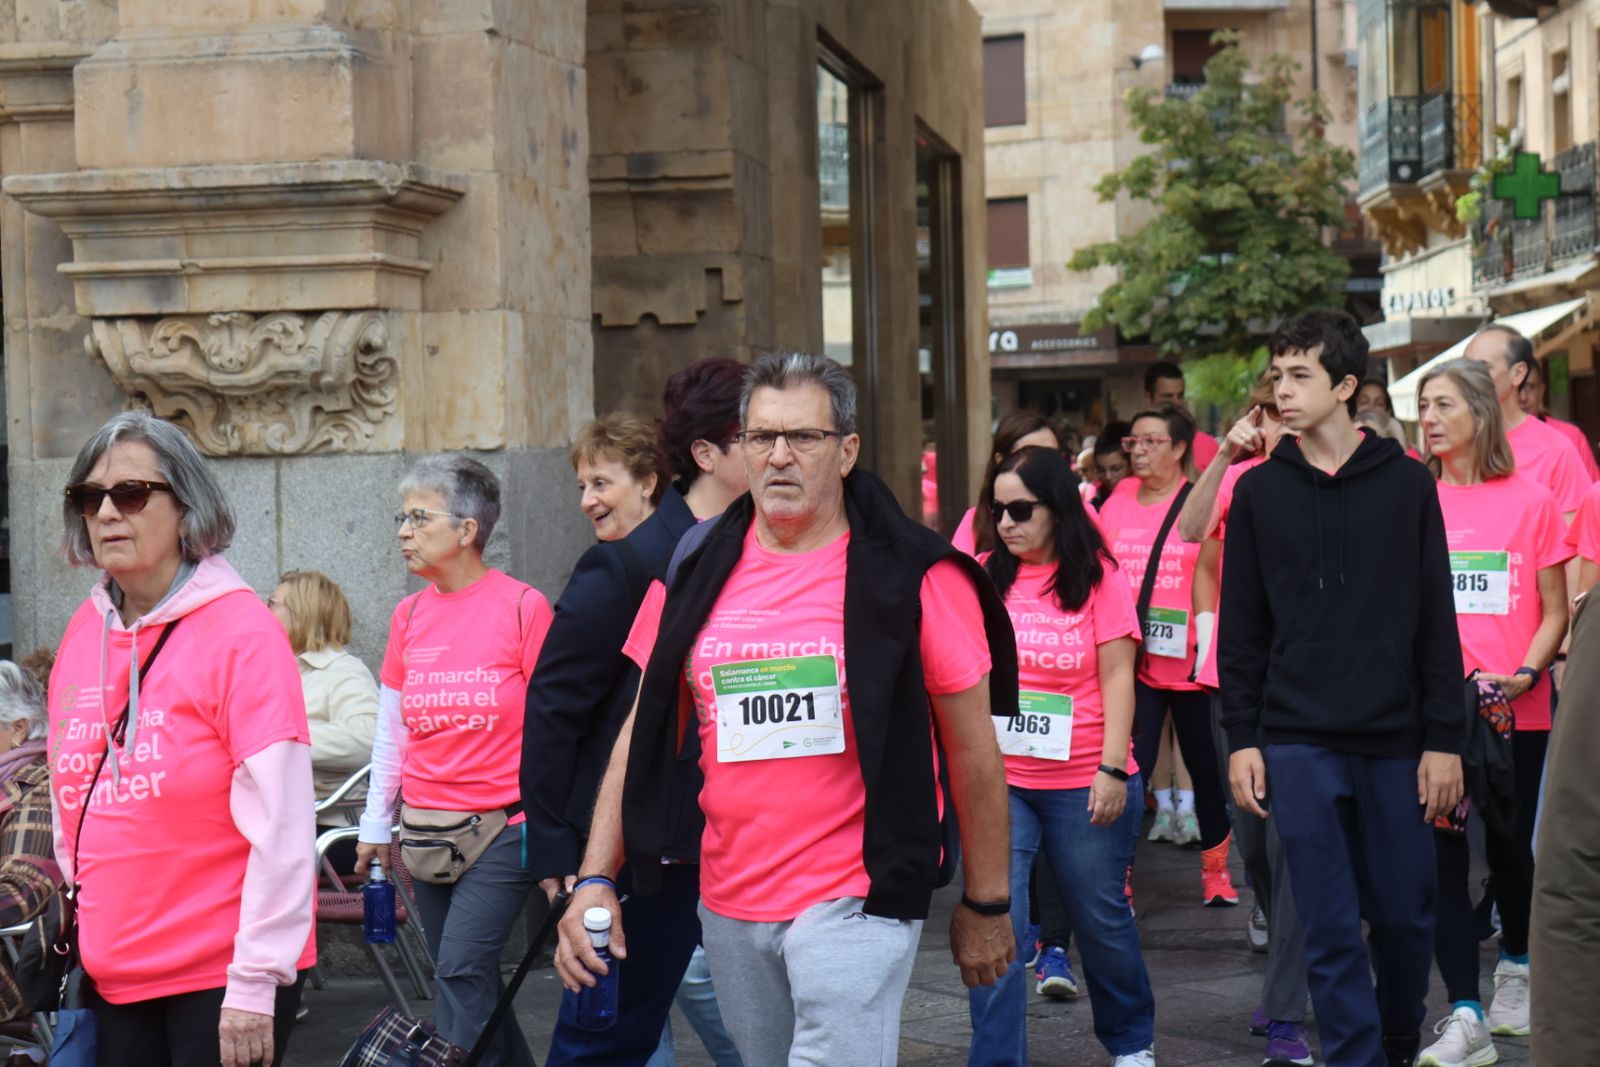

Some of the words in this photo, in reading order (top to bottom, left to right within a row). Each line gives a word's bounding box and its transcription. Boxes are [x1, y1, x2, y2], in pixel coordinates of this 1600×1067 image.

[699, 636, 732, 658] En
[1062, 628, 1084, 646] el
[407, 670, 424, 686] En
[428, 667, 500, 685] marcha
[720, 667, 759, 677] Salamanca
[769, 664, 797, 673] marcha
[721, 676, 745, 685] contra
[753, 673, 777, 682] cáncer
[404, 689, 471, 709] contra
[474, 687, 499, 707] el
[739, 692, 816, 725] 10021
[66, 718, 87, 740] En
[407, 710, 499, 734] cáncer
[135, 733, 163, 762] el
